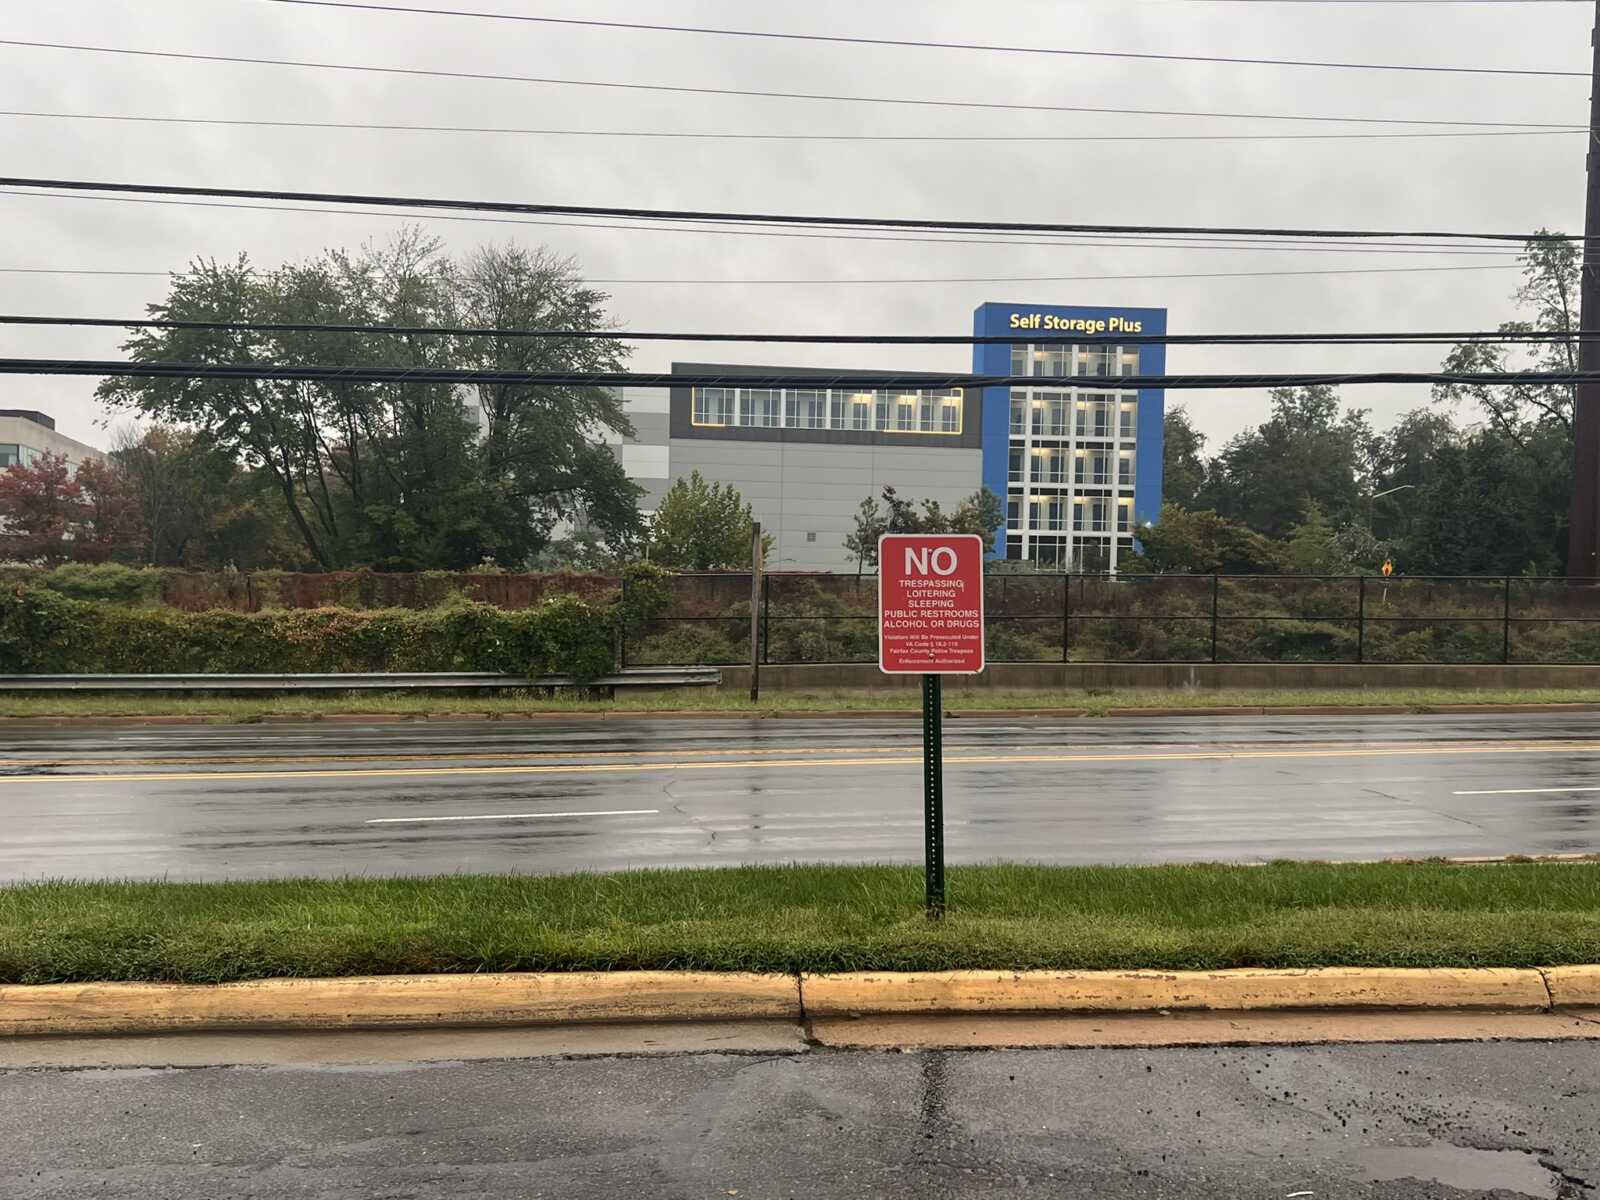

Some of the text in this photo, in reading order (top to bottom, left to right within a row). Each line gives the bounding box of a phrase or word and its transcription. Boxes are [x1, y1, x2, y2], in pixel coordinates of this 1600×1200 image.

[1010, 313, 1142, 334] Self Storage Plus
[904, 546, 958, 576] NO
[899, 579, 963, 588] TRESPASSING
[906, 589, 956, 598] LOITERING
[908, 599, 954, 608] SLEEPING
[884, 609, 979, 618] PUBLIC RESTROOMS
[883, 620, 980, 628] ALCOHOL OR DRUGS
